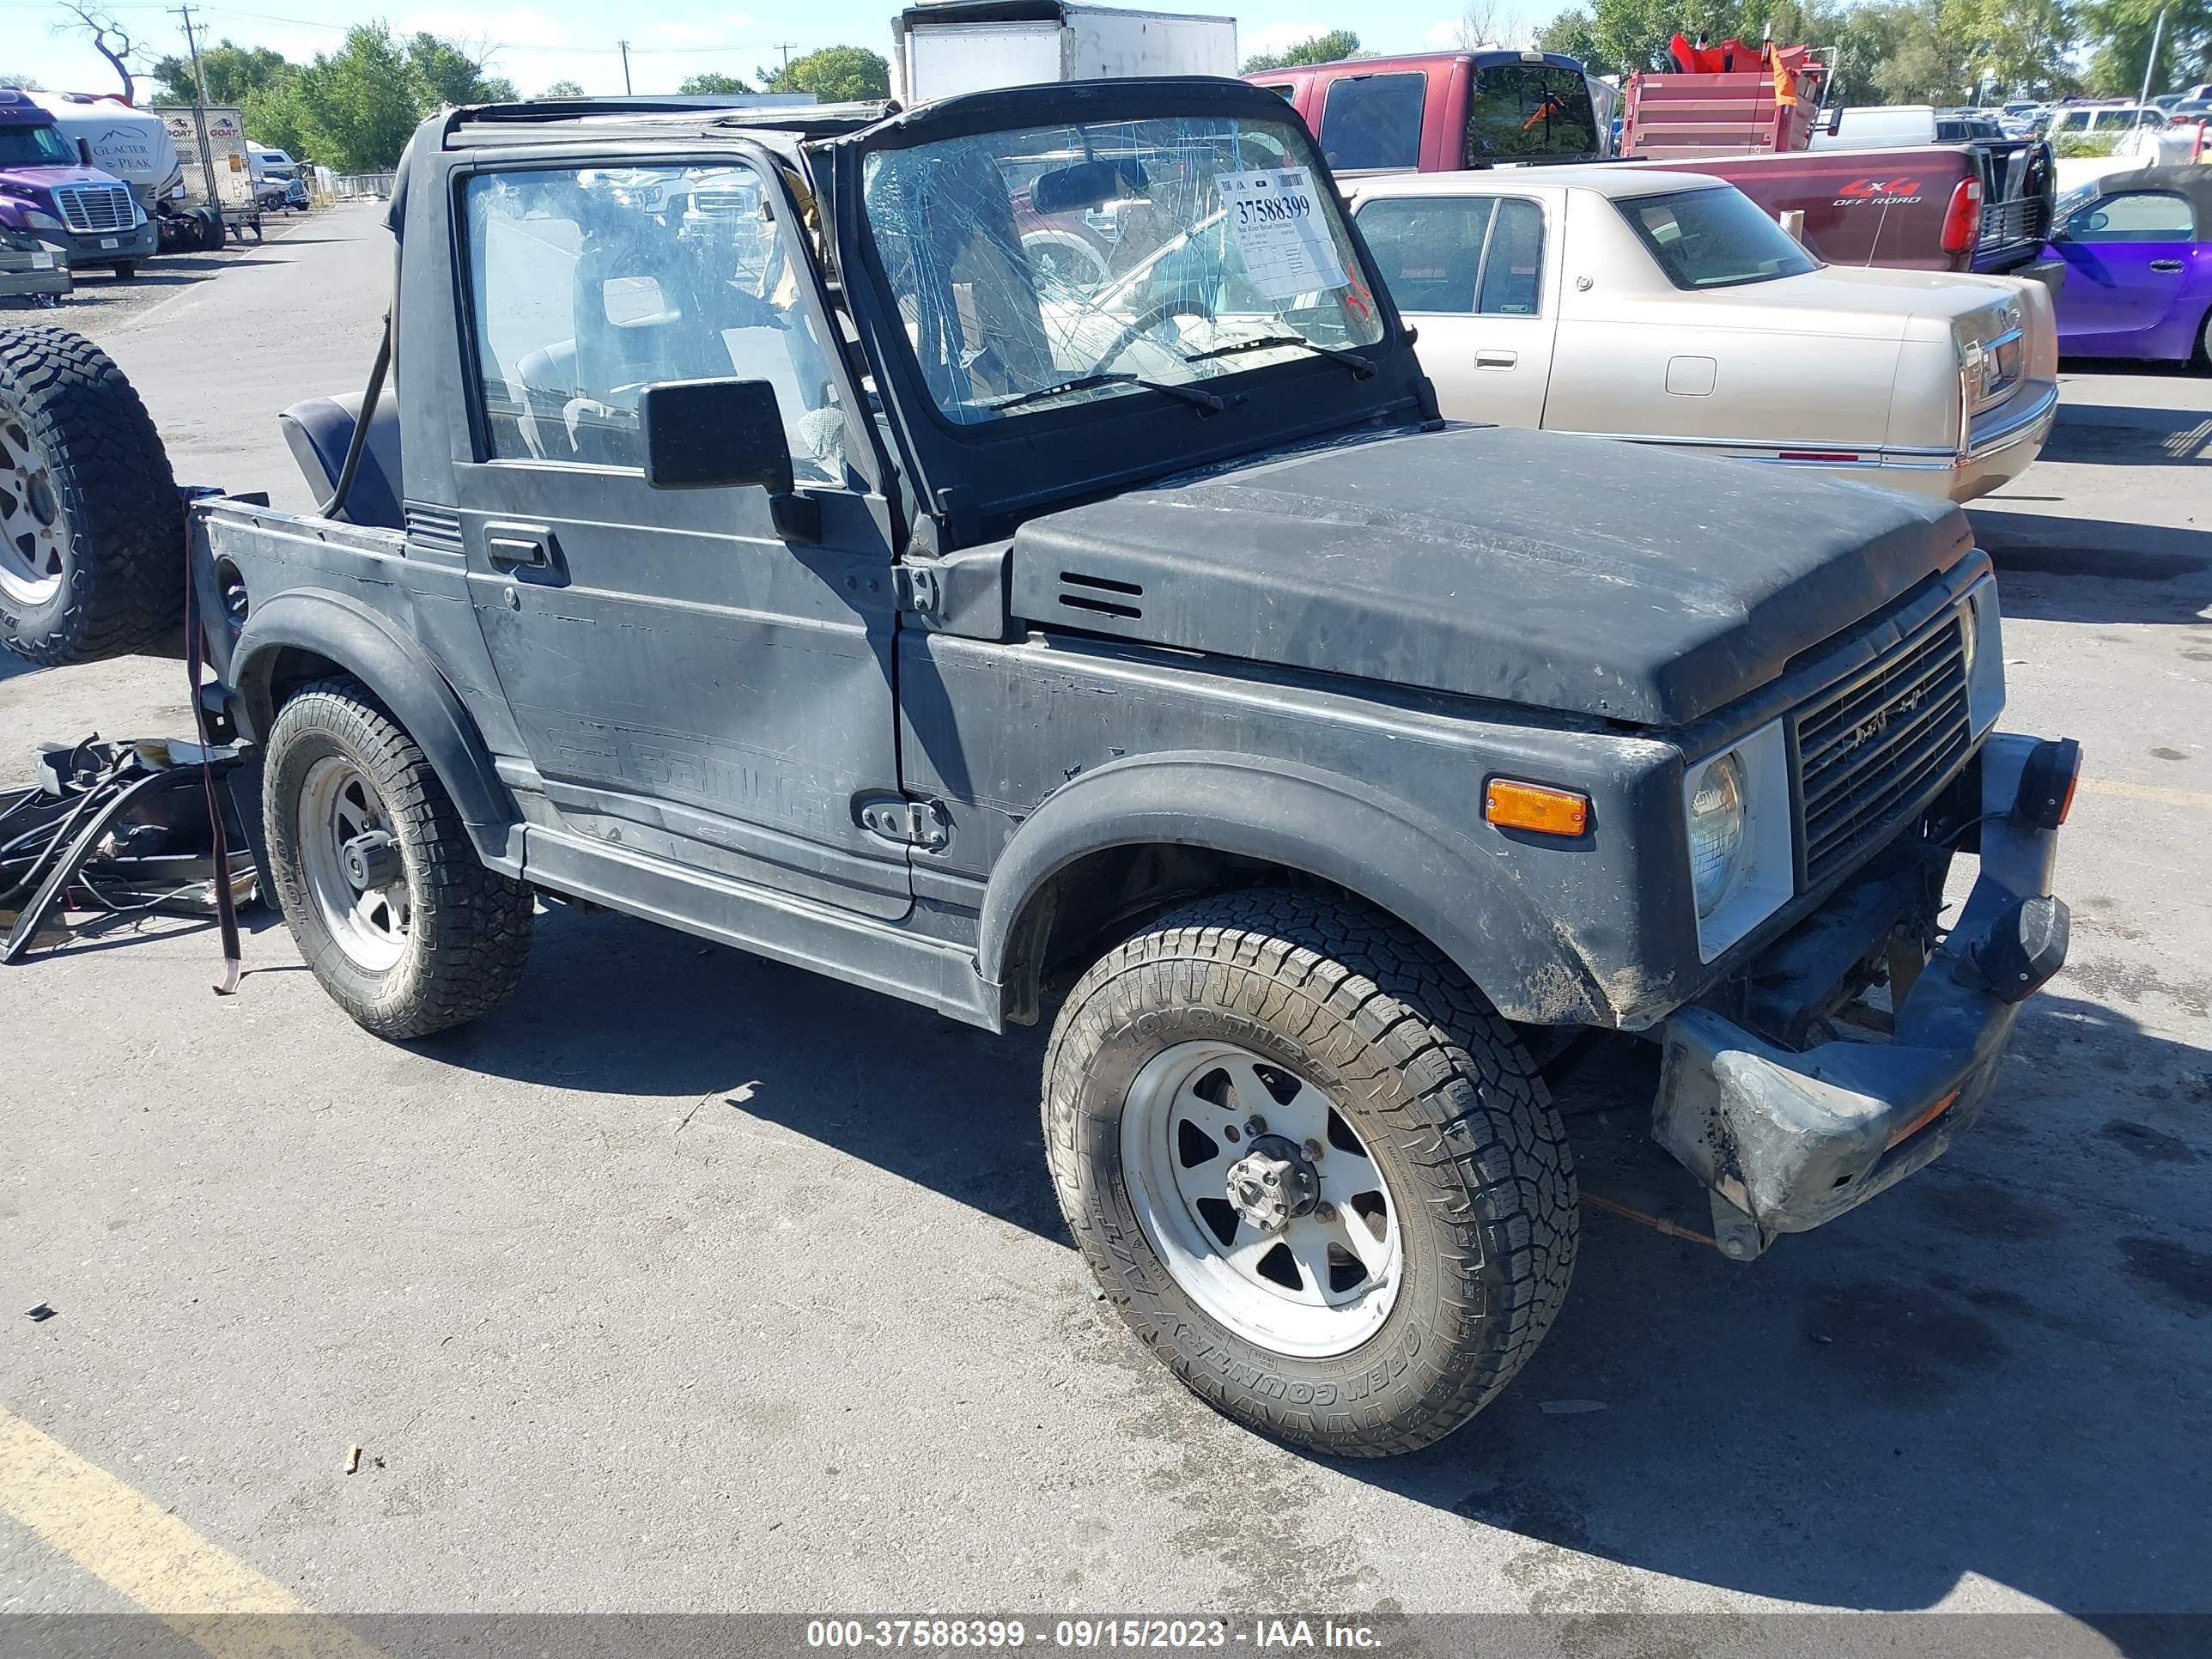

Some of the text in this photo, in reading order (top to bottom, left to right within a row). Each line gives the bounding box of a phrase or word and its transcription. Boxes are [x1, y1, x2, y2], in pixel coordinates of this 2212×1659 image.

[210, 129, 238, 137] GOAT
[94, 145, 148, 156] GLACIER
[118, 158, 151, 168] PEAK
[1871, 197, 1923, 205] ROAD
[1237, 195, 1310, 224] 37588399
[1346, 1322, 1421, 1402] OPEN
